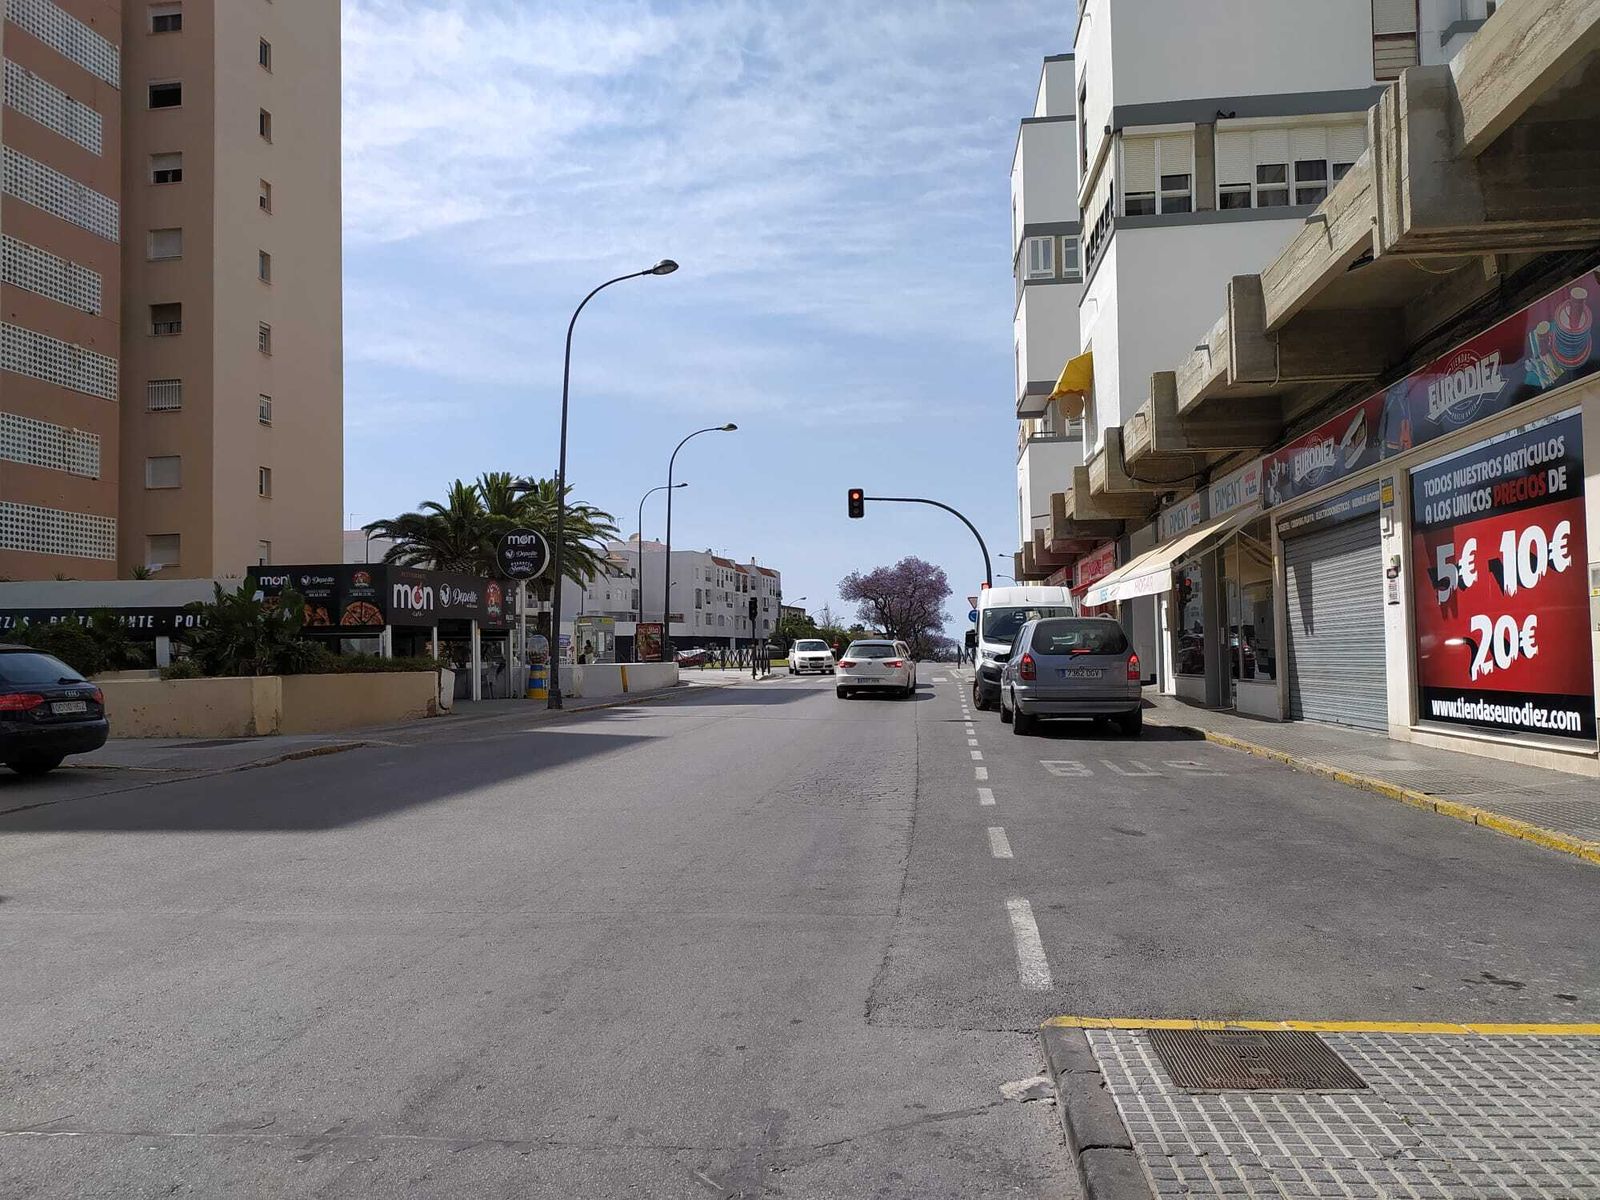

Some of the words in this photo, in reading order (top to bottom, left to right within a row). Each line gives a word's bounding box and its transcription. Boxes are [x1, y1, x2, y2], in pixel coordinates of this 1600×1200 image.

[1428, 352, 1500, 414] EURODIEZ
[1294, 437, 1335, 478] EURODIEZ
[1424, 473, 1452, 498] TODOS
[1453, 457, 1502, 489] NUESTROS
[1504, 435, 1565, 474] ARTÍCULOS
[1425, 505, 1432, 524] A
[1434, 499, 1451, 523] LOS
[1453, 488, 1492, 517] ÚNICOS
[1493, 471, 1547, 507] PRECIOS
[1548, 466, 1567, 494] DE
[1436, 537, 1478, 605] 5€
[1500, 520, 1572, 597] 10€
[1470, 614, 1539, 682] 20€
[1432, 697, 1581, 731] www.tiendaseurodiez.com
[1040, 760, 1229, 777] BUS
